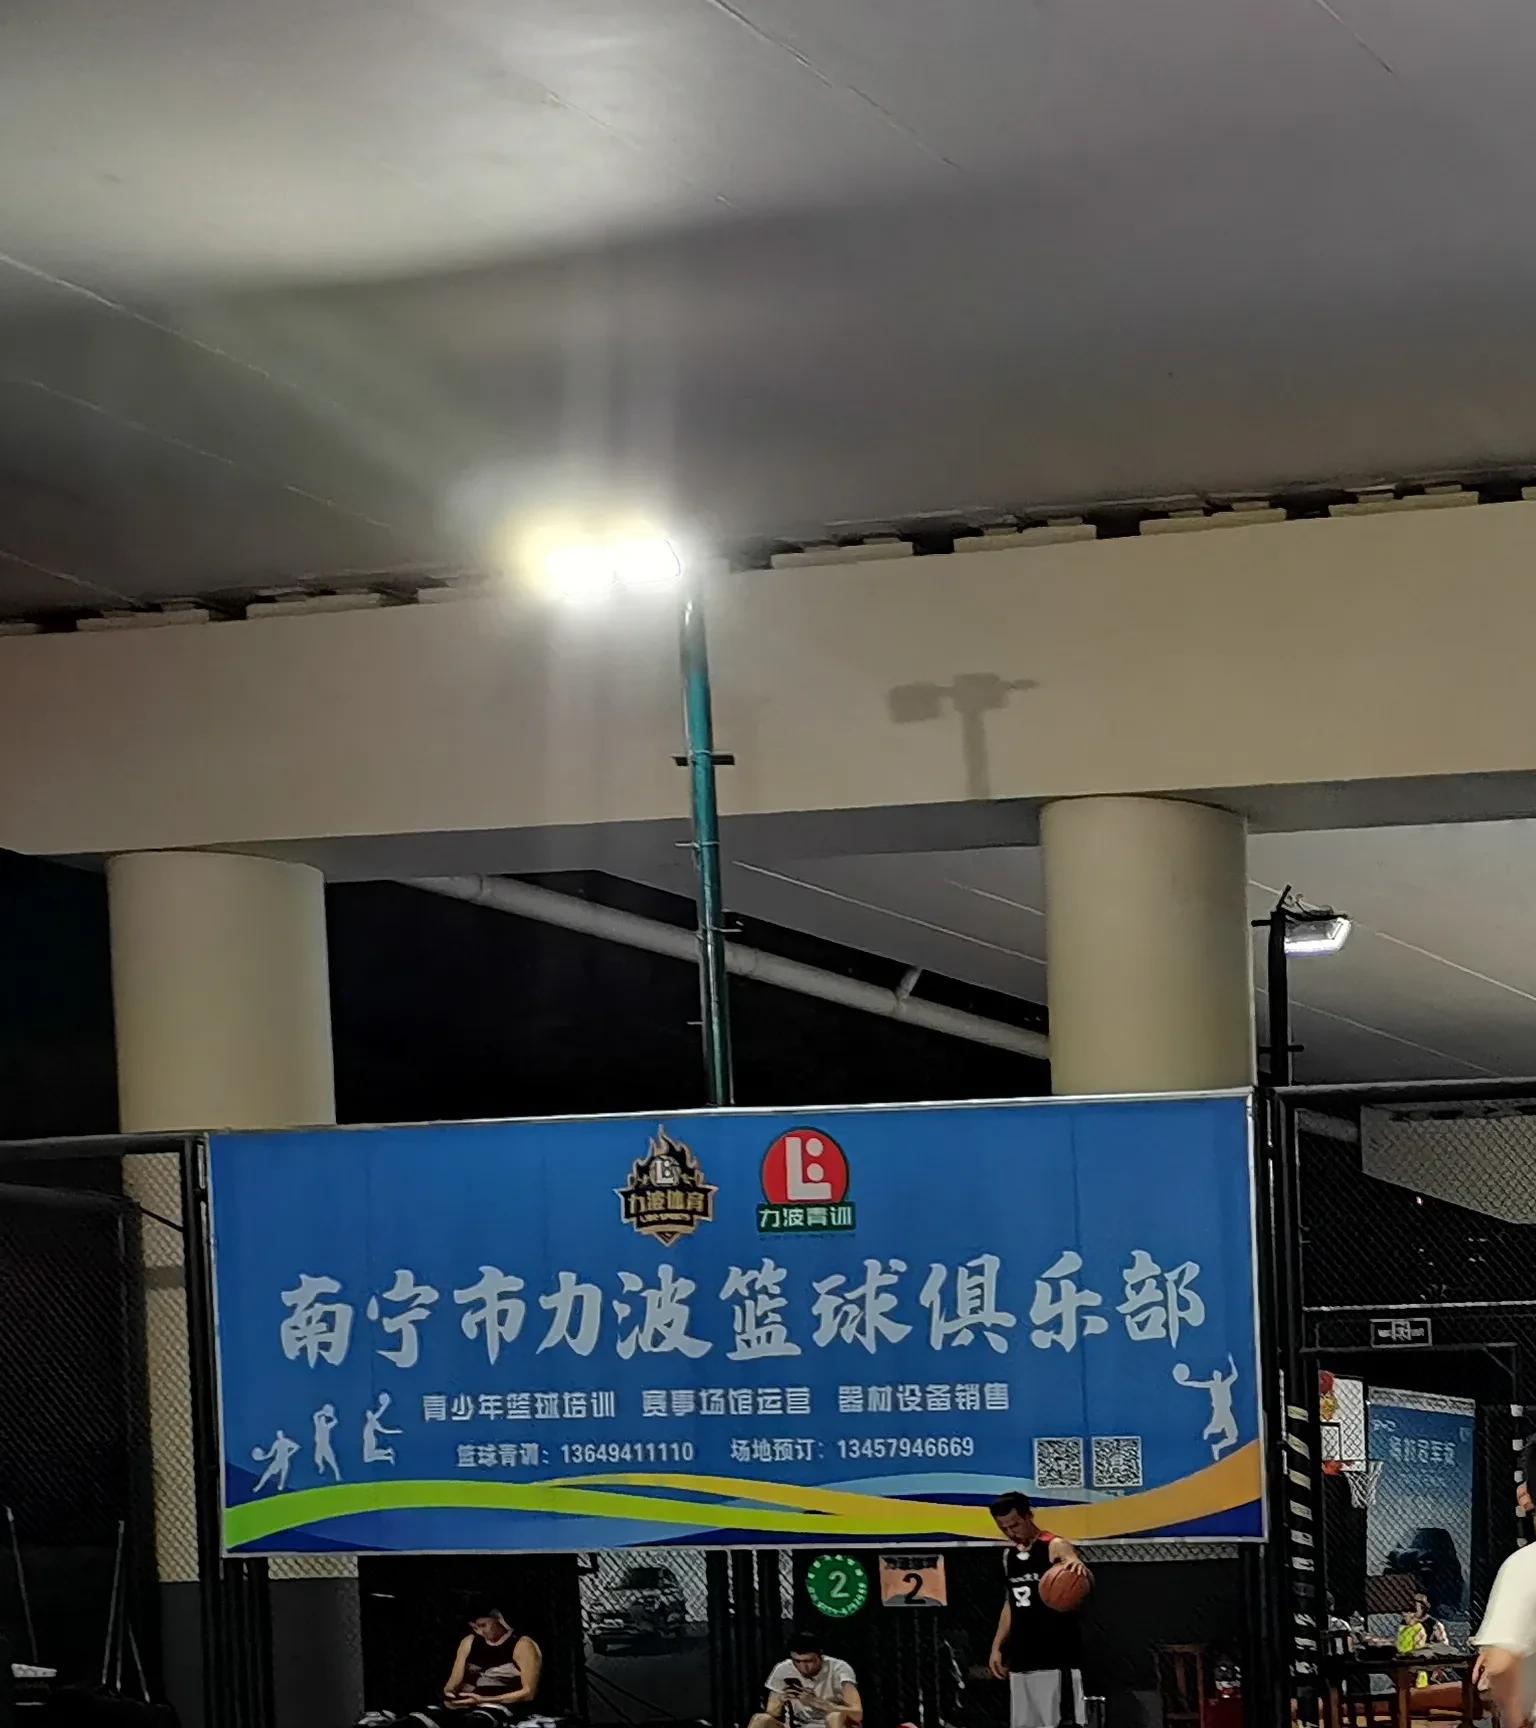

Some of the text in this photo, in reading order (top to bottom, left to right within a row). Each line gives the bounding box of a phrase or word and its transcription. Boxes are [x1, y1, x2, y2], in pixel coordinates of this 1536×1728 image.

[628, 1190, 705, 1213] 力波体育
[759, 1206, 852, 1228] 力波青训
[281, 1250, 1205, 1368] 南宁市力波篮球俱乐部
[422, 1383, 1010, 1422] 青少年篮球培训 赛事场馆运营 器材设备销售
[561, 1441, 694, 1463] 13649411110
[837, 1437, 974, 1459] 13457946669
[828, 1571, 849, 1598] 2
[903, 1572, 926, 1604] 2
